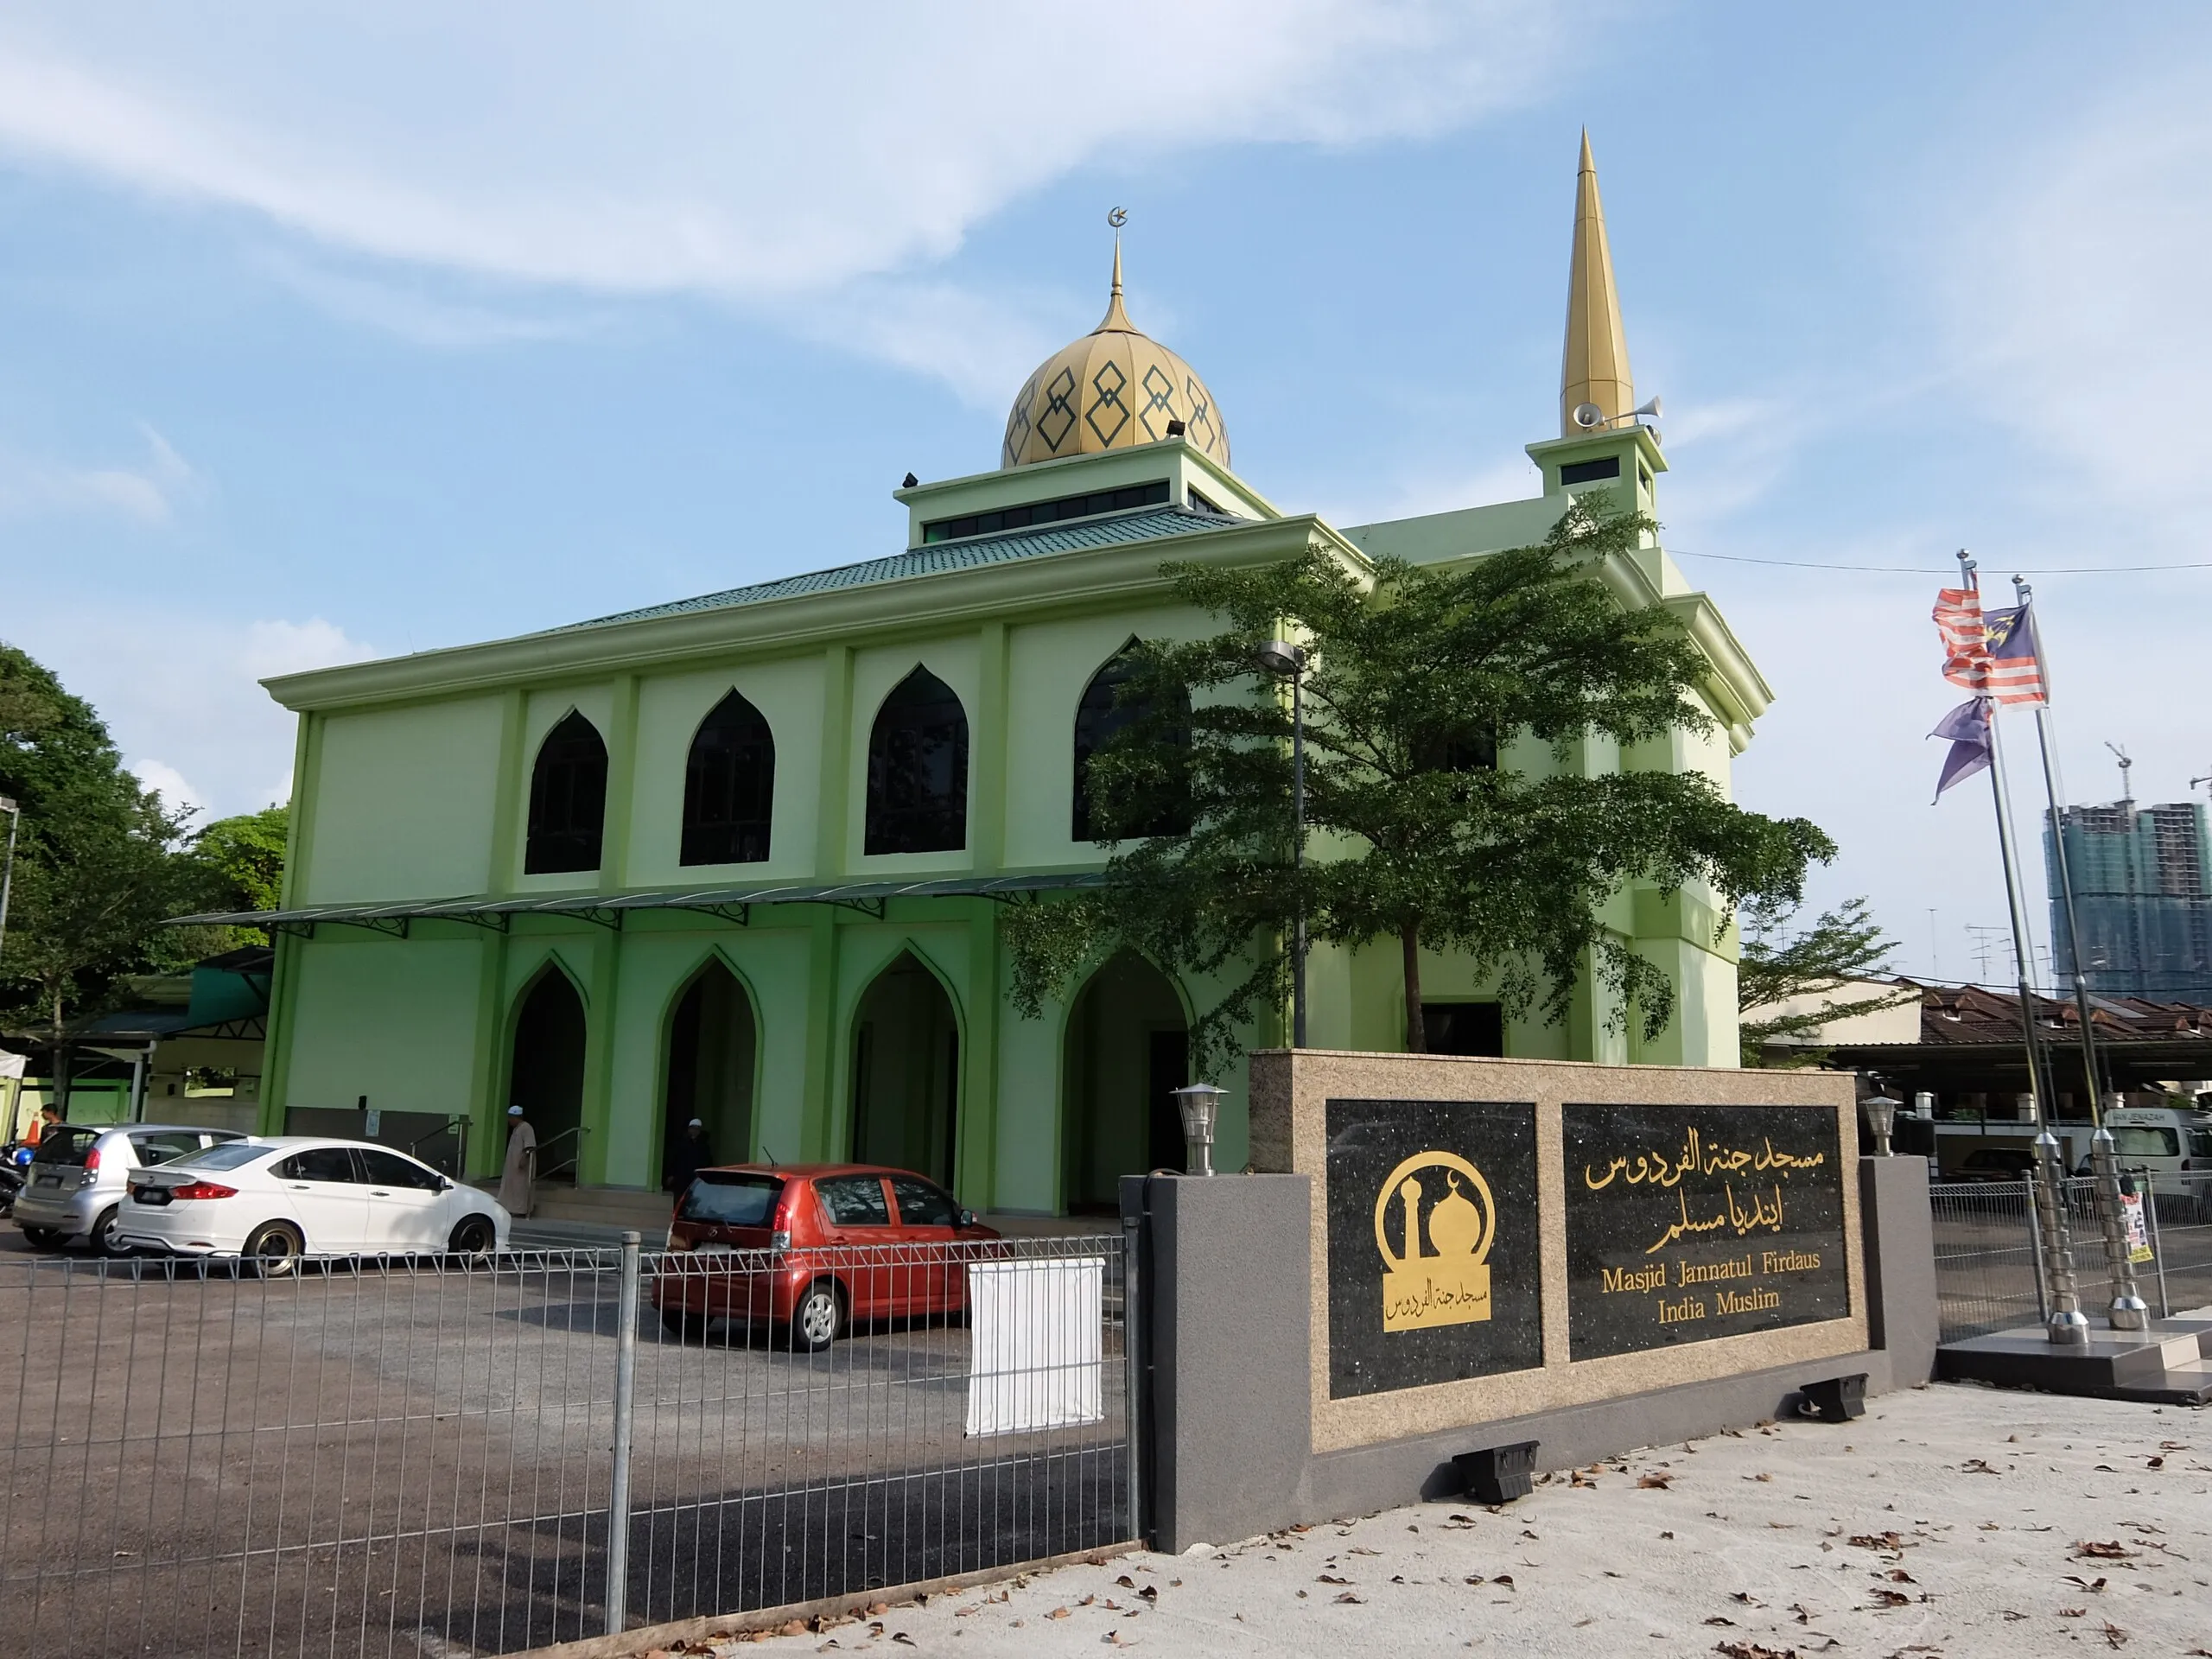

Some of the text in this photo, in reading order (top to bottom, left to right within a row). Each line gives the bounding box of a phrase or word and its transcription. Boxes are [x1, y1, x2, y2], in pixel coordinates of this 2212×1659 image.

[1586, 1126, 1824, 1190] مسجد جنة الفردوس
[1645, 1186, 1725, 1254] مسلم
[1602, 1250, 1821, 1294] Masjid Jannatul Firdaus
[1386, 1277, 1487, 1320] مسجد جنة الفردوس
[1657, 1287, 1780, 1324] India Muslim
